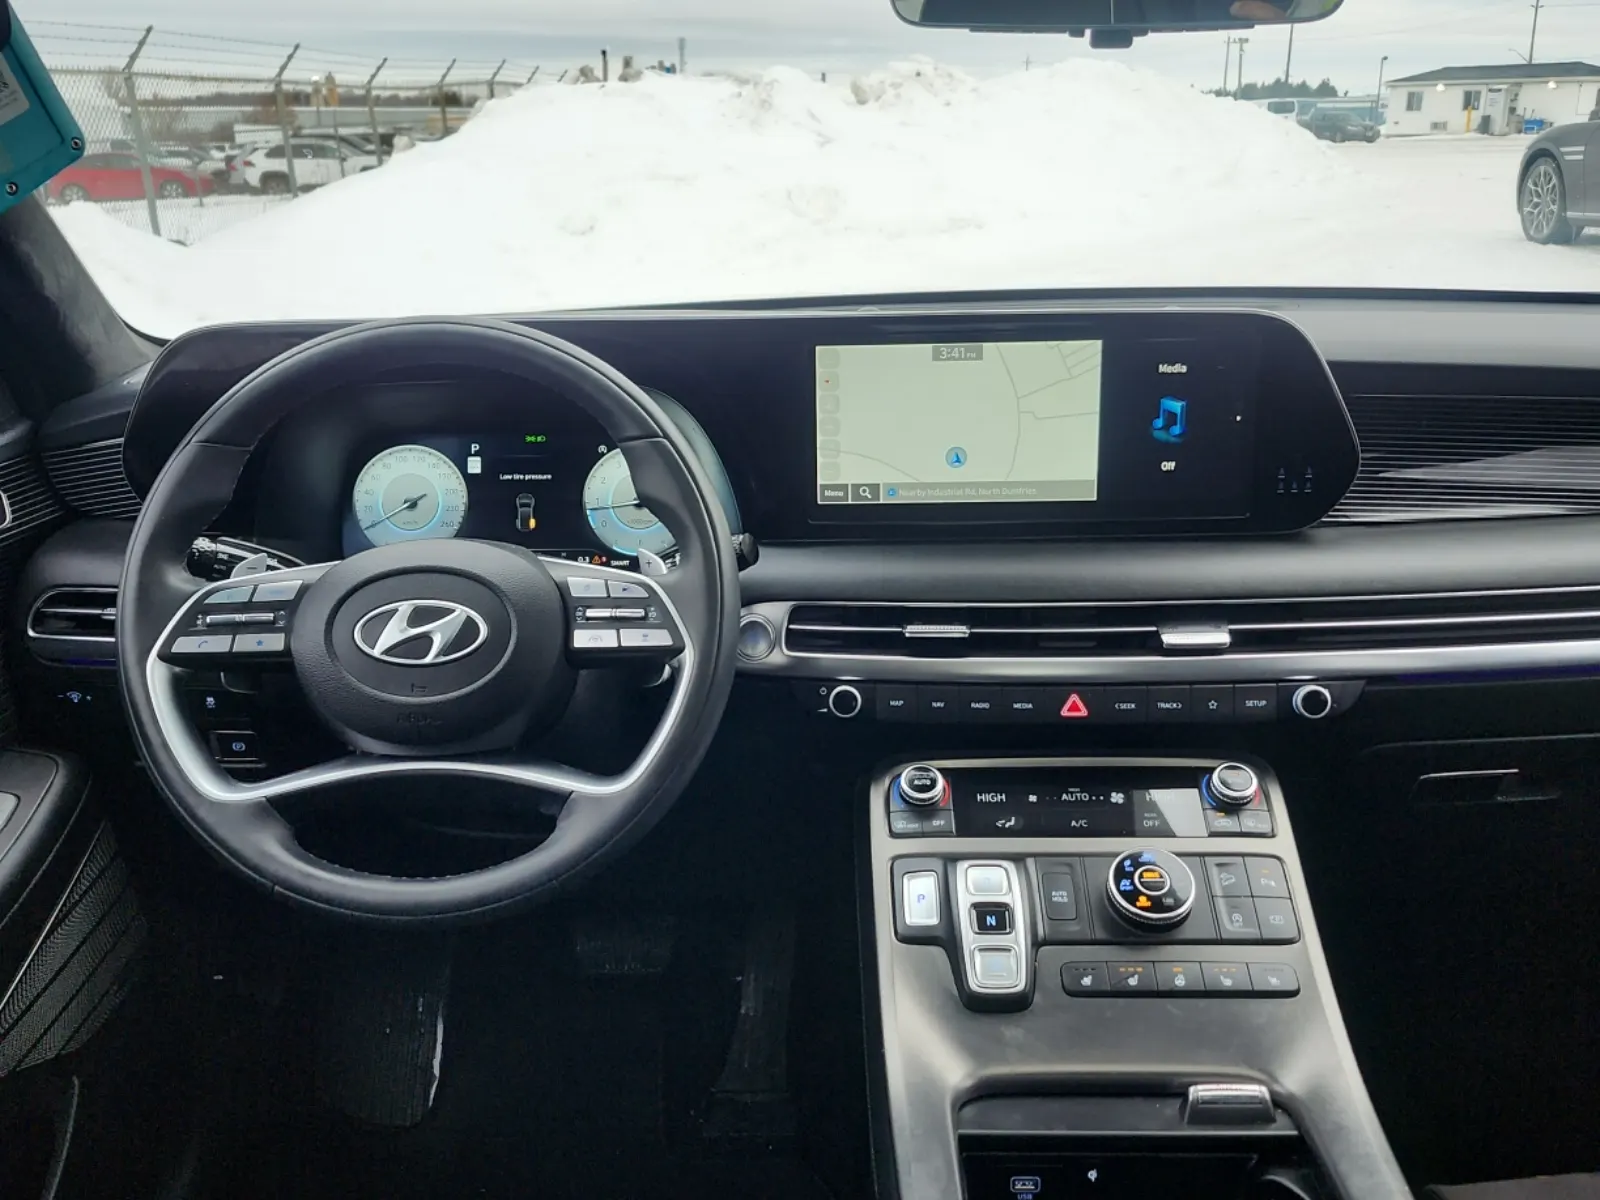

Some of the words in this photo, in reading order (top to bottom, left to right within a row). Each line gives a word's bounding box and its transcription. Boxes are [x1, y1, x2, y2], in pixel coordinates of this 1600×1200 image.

[939, 347, 965, 359] 3:41
[1158, 363, 1188, 374] Media
[470, 443, 480, 455] P
[1160, 460, 1176, 472] Off
[499, 473, 513, 481] Low
[600, 476, 607, 485] 2
[824, 489, 844, 497] Menu
[978, 486, 1001, 495] North
[889, 699, 904, 707] MAP
[931, 701, 945, 709] NAV
[970, 701, 990, 710] RADIO
[1012, 702, 1034, 710] MEDIA
[1244, 699, 1268, 708] SETUP
[976, 792, 1006, 803] HIGH
[1060, 792, 1090, 802] AUTO
[1070, 819, 1089, 828] A/C
[1143, 819, 1161, 828] OFF
[917, 893, 926, 904] P
[985, 914, 997, 927] N
